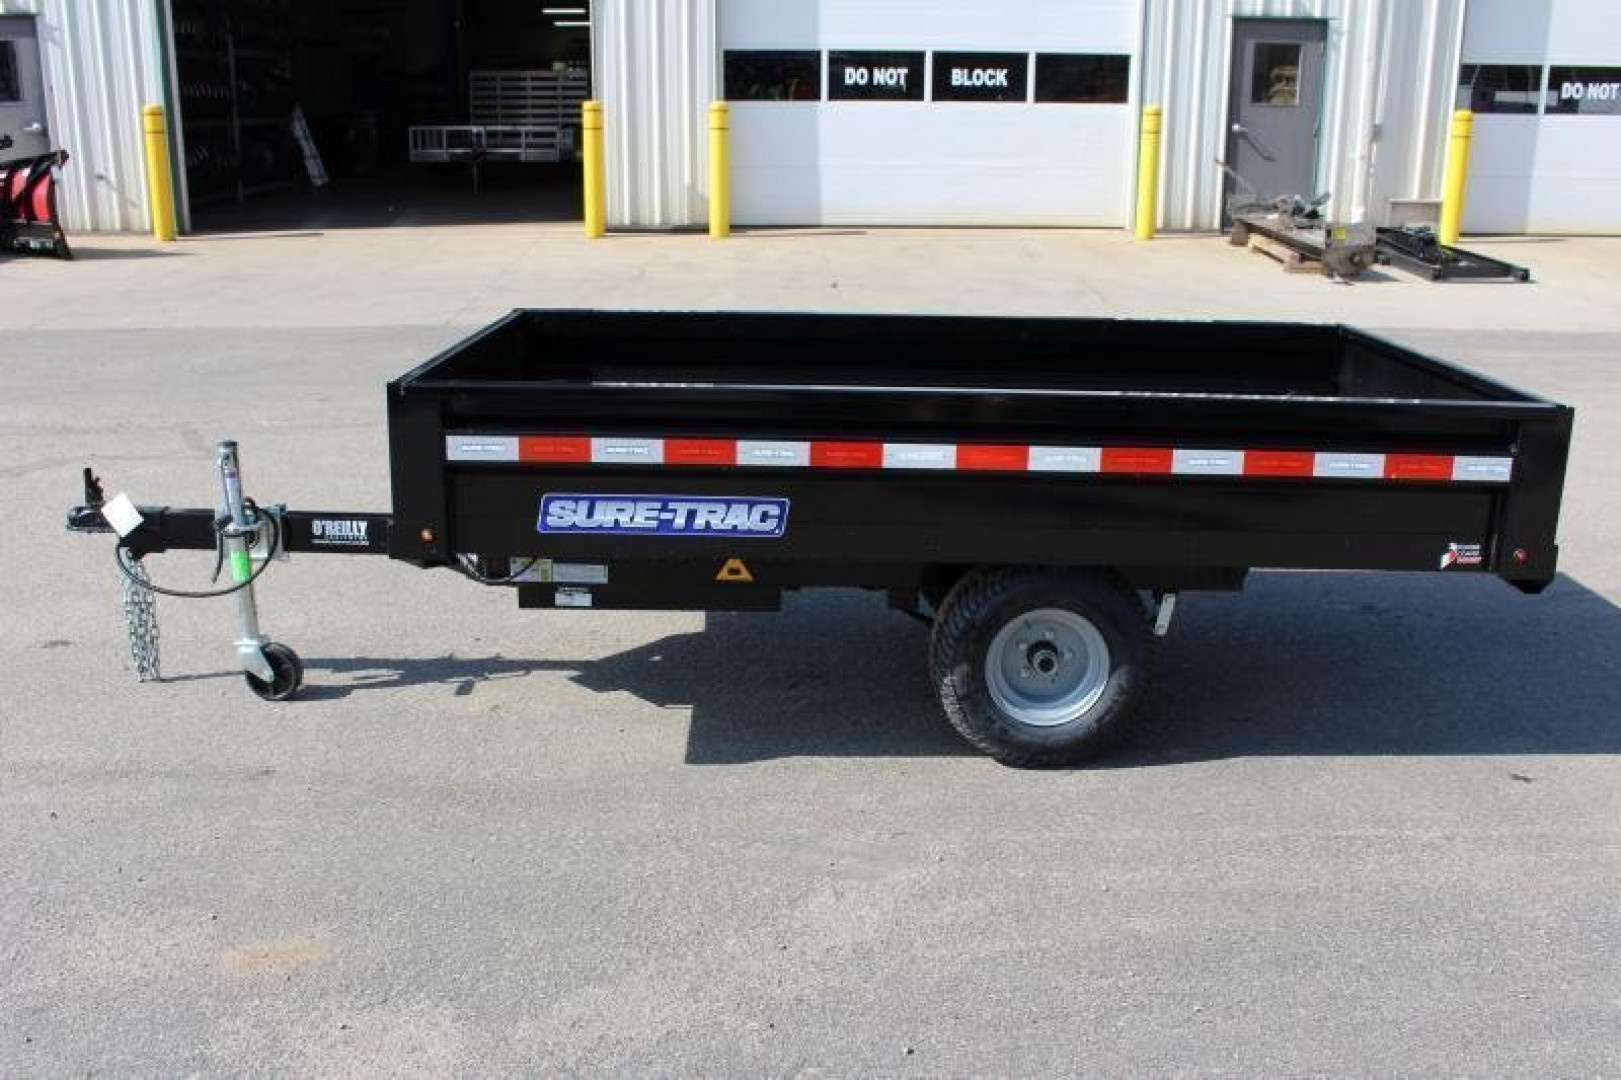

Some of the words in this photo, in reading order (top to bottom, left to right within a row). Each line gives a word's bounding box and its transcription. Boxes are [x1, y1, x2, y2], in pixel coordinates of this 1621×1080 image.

[844, 66, 869, 86] DO
[873, 66, 908, 86] NOT
[951, 68, 1008, 88] BLOCK
[1561, 81, 1583, 99] DO
[1588, 82, 1620, 100] NOT
[547, 500, 781, 532] SURE-TRAC
[312, 519, 368, 536] O'REILLY
